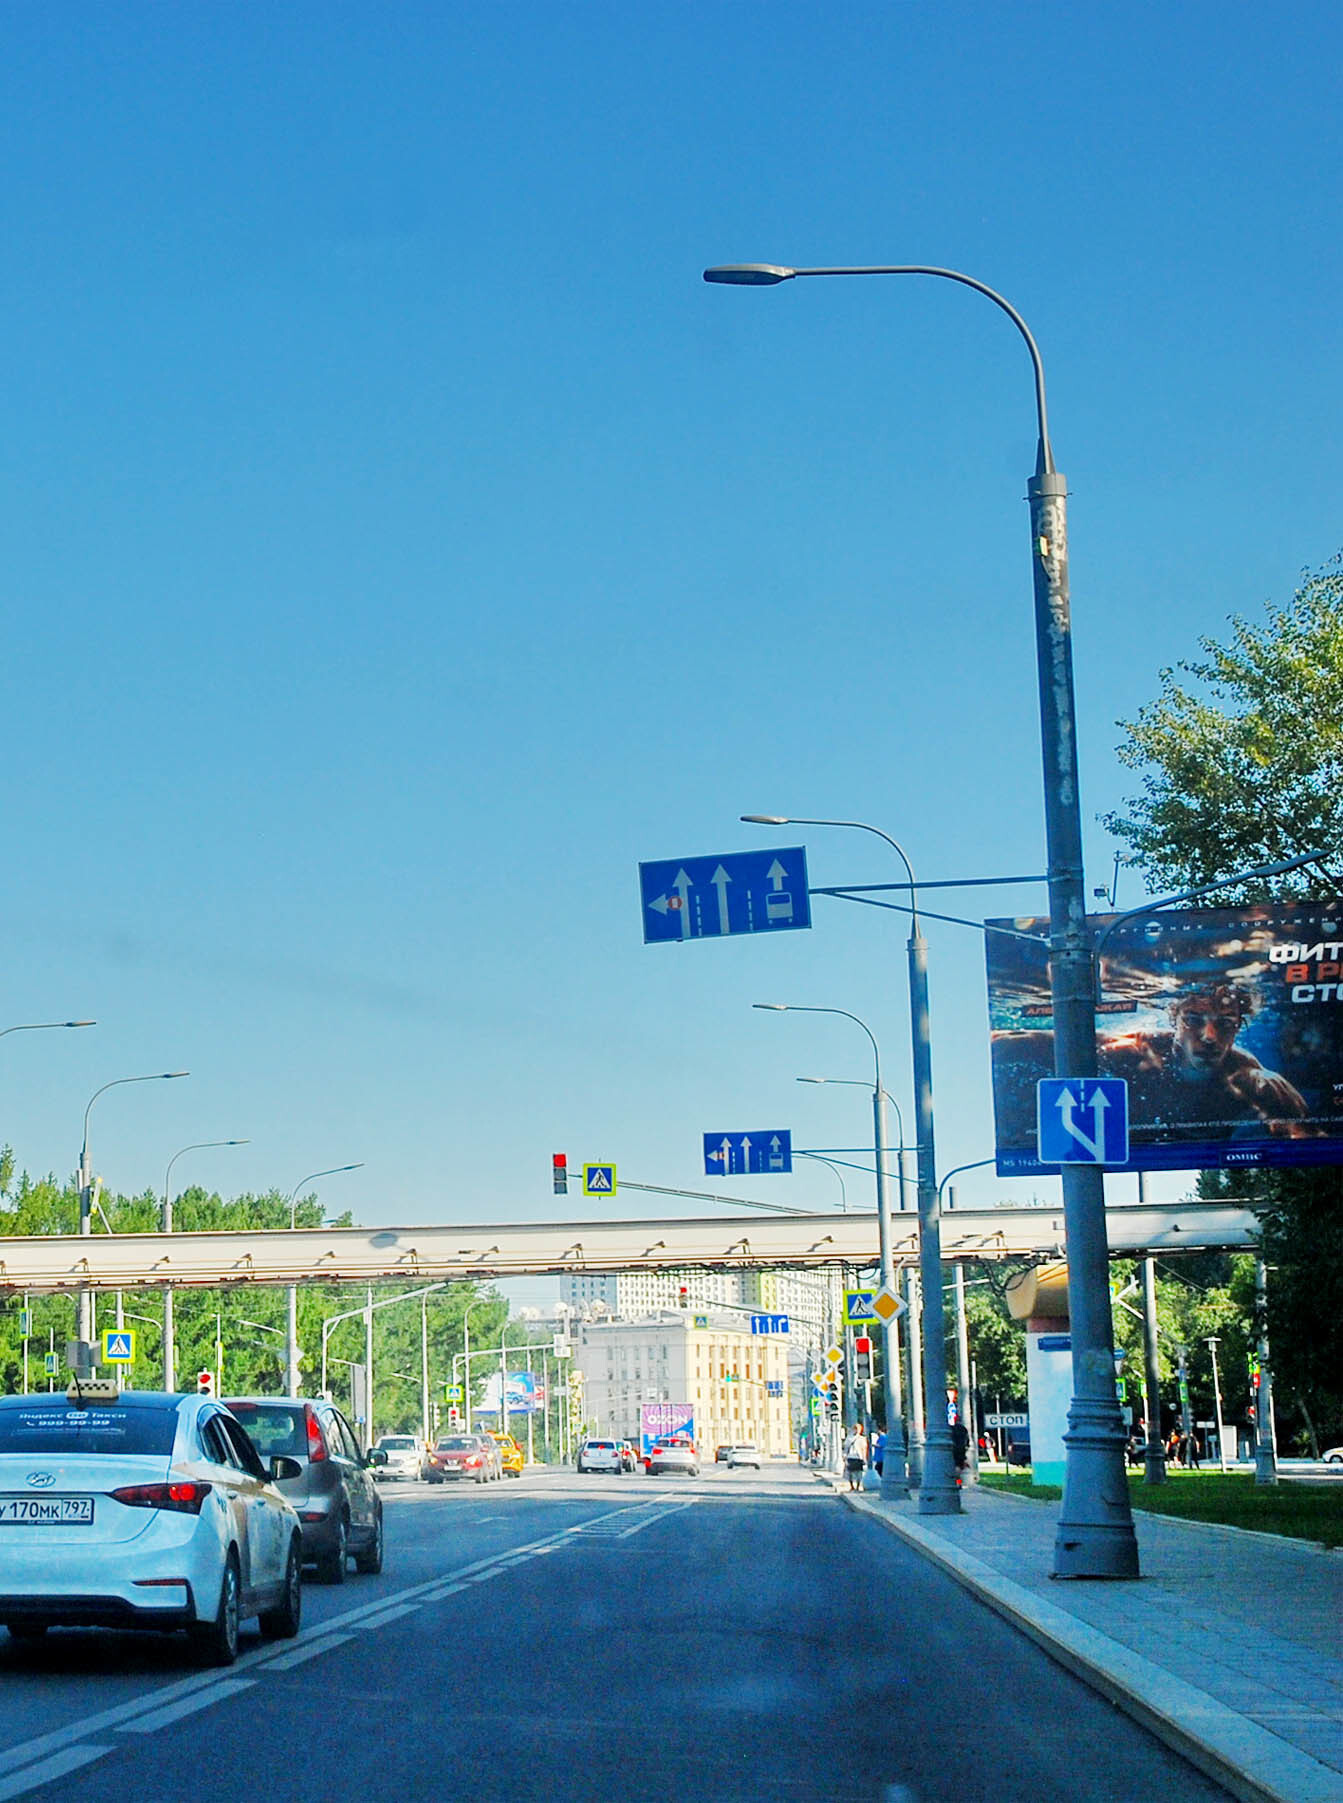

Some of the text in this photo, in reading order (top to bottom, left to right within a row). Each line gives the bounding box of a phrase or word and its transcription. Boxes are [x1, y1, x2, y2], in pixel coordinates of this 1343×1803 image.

[1285, 962, 1343, 983] В Р
[989, 1415, 1023, 1425] СТОП
[63, 1501, 88, 1514] 797
